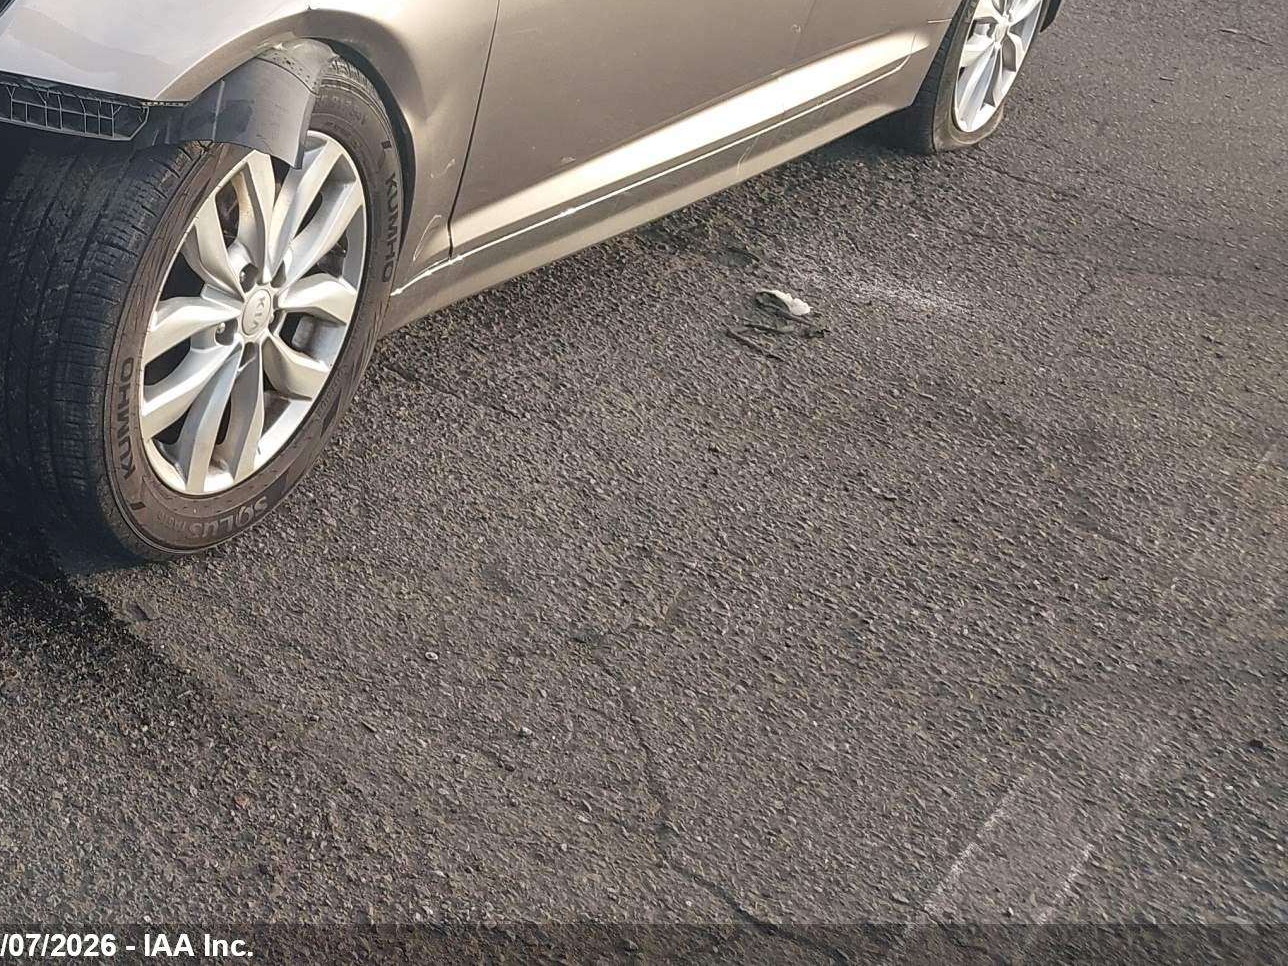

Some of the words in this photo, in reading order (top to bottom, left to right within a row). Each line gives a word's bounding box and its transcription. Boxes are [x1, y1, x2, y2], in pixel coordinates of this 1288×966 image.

[383, 172, 400, 283] KUMHO
[116, 356, 137, 480] KUMHO
[186, 495, 268, 539] SOLUS
